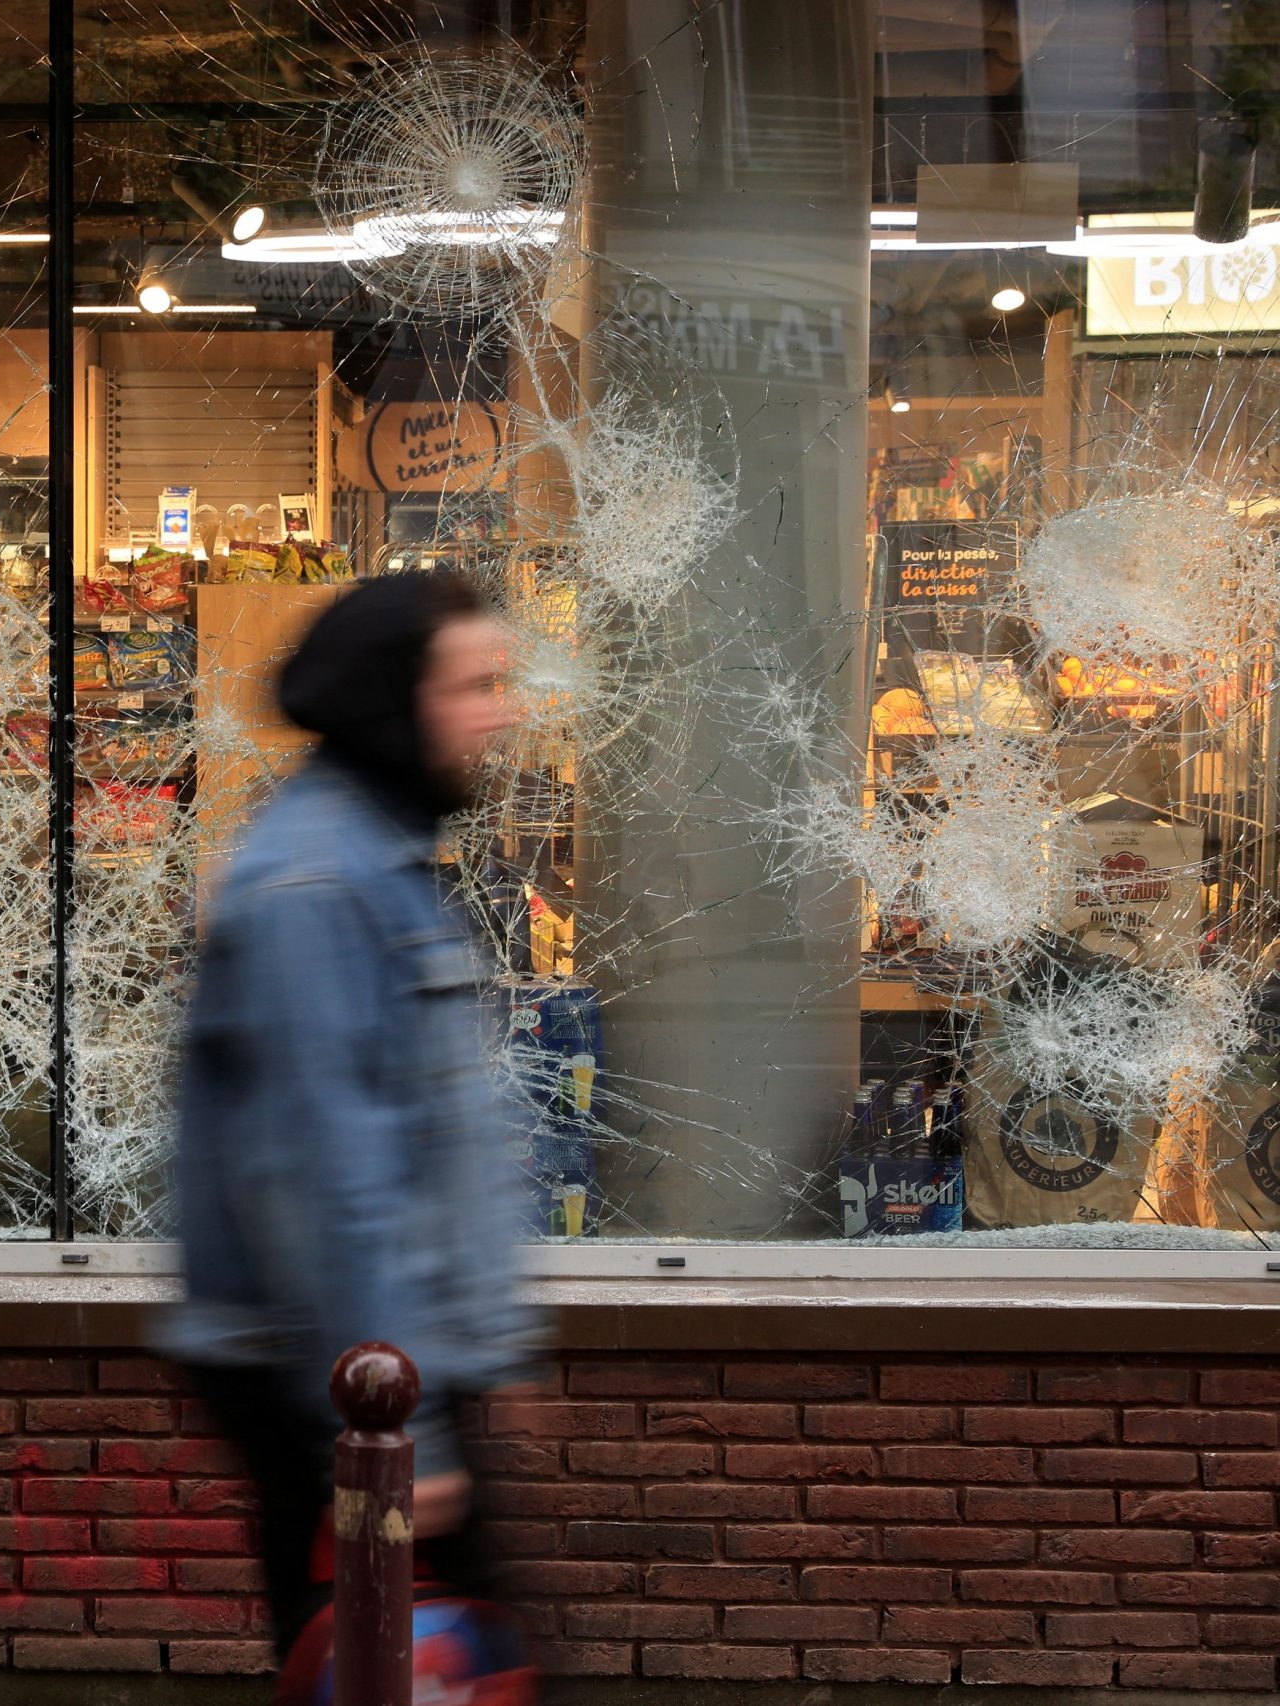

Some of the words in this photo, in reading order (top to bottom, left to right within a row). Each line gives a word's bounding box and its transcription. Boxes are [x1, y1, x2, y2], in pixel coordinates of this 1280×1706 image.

[409, 440, 431, 459] et
[902, 550, 935, 561] Pour
[902, 581, 923, 596] la
[925, 583, 978, 597] caisse
[886, 1213, 921, 1224] BEER
